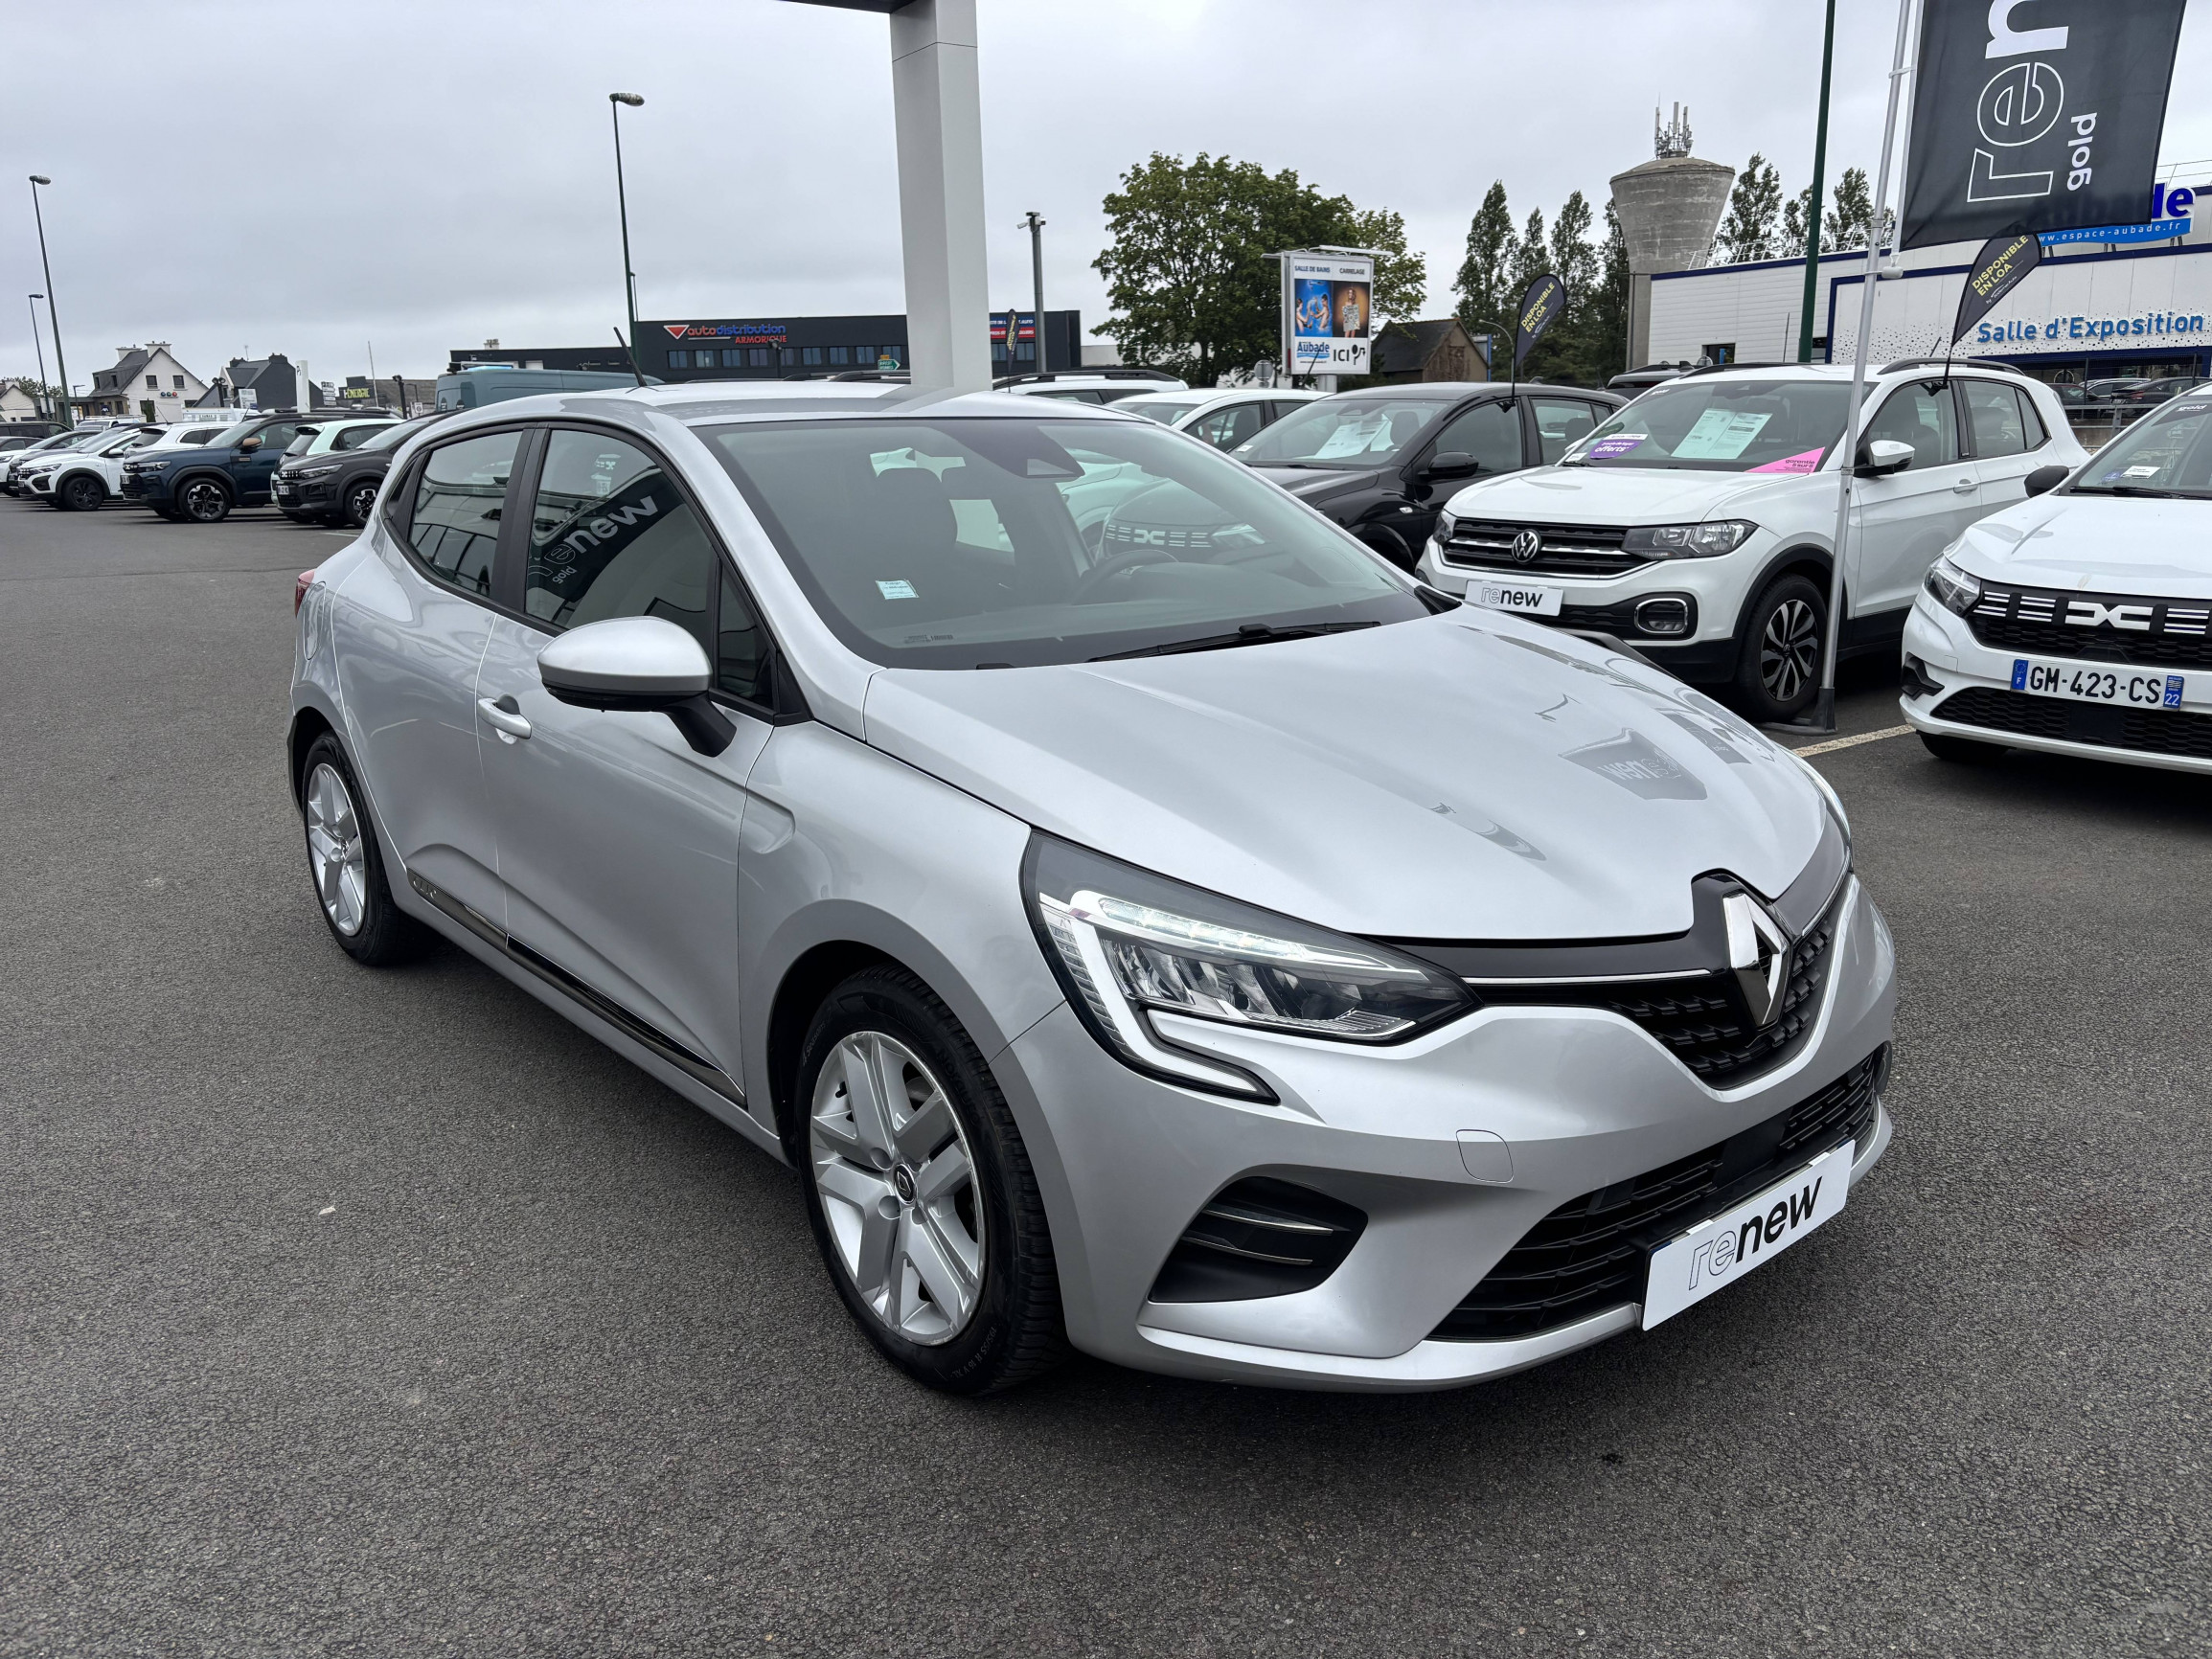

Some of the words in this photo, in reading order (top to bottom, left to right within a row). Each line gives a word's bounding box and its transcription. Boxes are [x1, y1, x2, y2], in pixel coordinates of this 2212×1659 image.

[2067, 112, 2098, 192] gold
[1972, 235, 2029, 289] DISPONIBLE
[1977, 281, 1993, 296] EN
[1991, 263, 2013, 284] LOA
[1521, 282, 1555, 328] DISPONIBLE
[1525, 321, 1537, 333] EN
[1533, 306, 1547, 323] LOA
[687, 324, 787, 336] autodistribution
[1977, 320, 2037, 343] Salle
[2045, 312, 2203, 341] d'Exposition
[1297, 342, 1330, 352] Aubade
[1334, 350, 1350, 361] ICI
[552, 566, 577, 584] gold
[1481, 587, 1543, 607] renew
[2030, 666, 2161, 704] GM-423-CS
[2164, 693, 2179, 706] 22
[1689, 1176, 1822, 1291] renew
